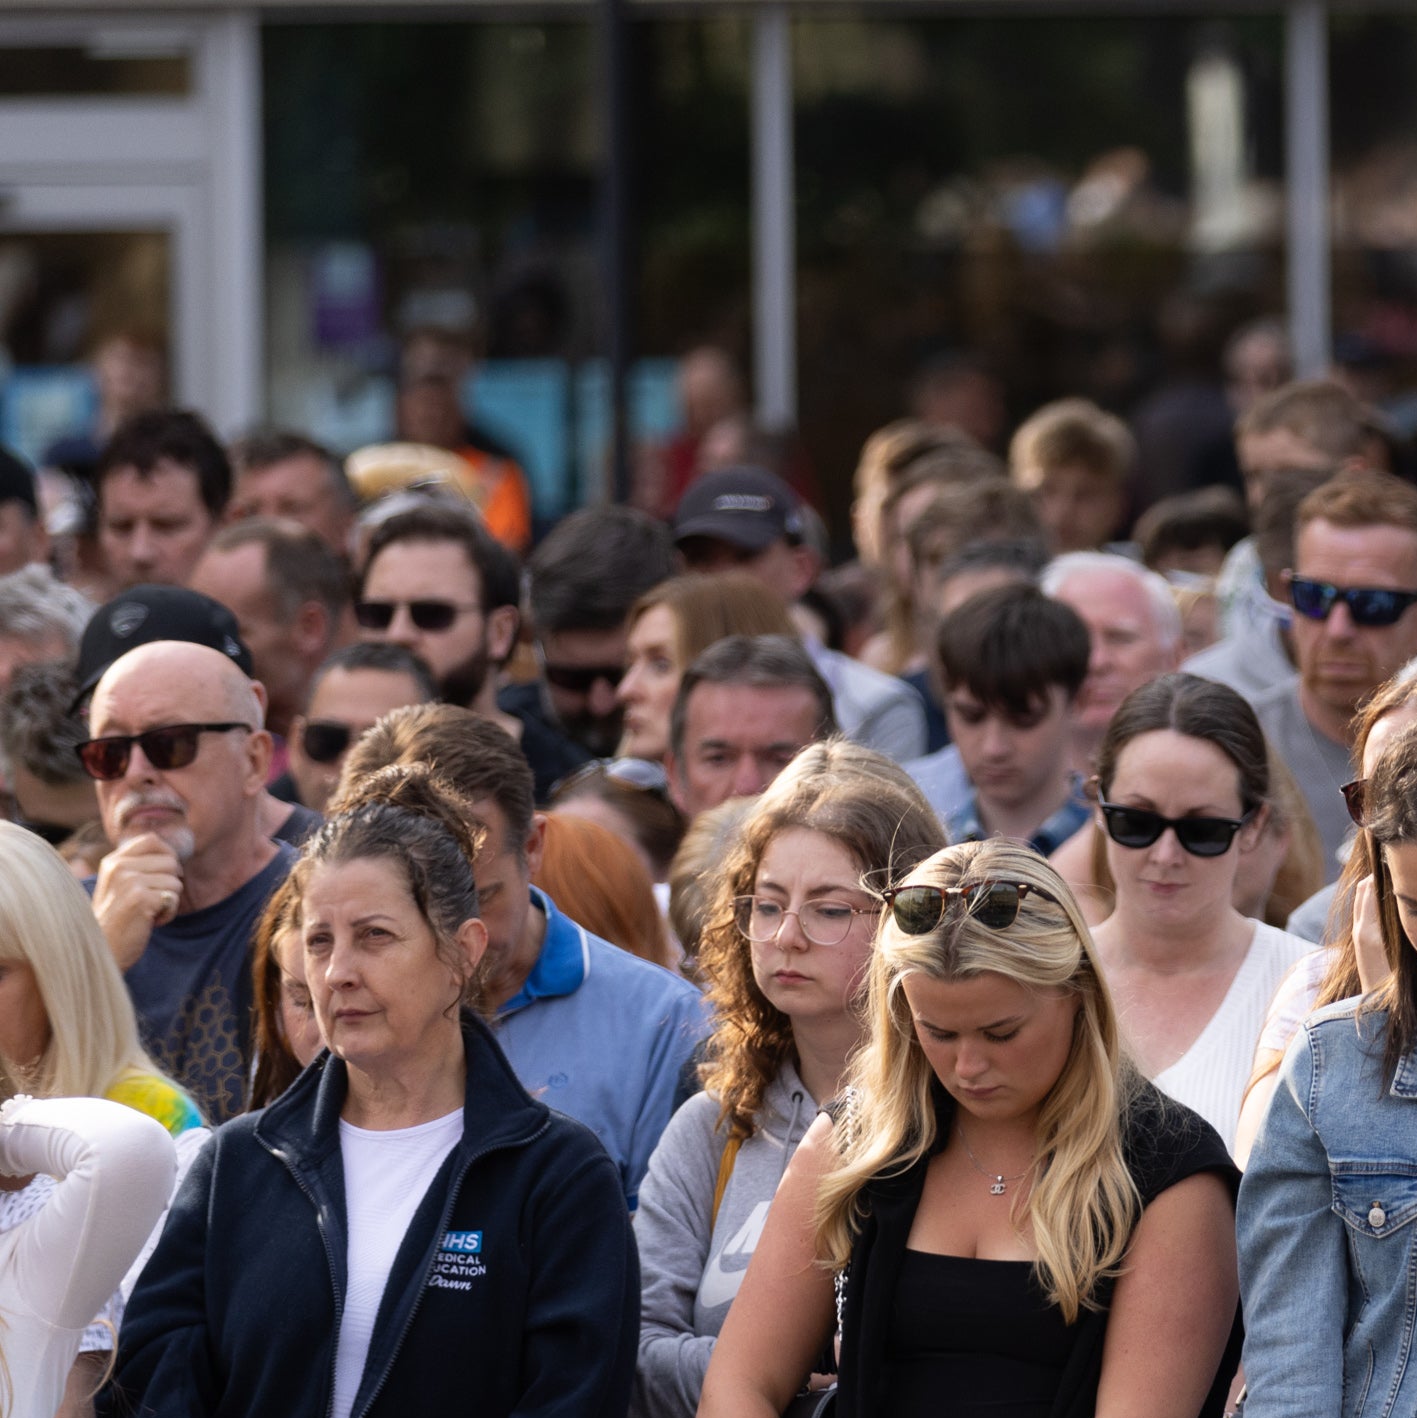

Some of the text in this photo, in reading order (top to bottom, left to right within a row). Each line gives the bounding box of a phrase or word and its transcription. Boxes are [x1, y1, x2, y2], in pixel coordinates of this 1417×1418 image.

[437, 1253, 481, 1265] EDICAL
[433, 1263, 487, 1277] UCATION
[428, 1275, 472, 1291] Dawn
